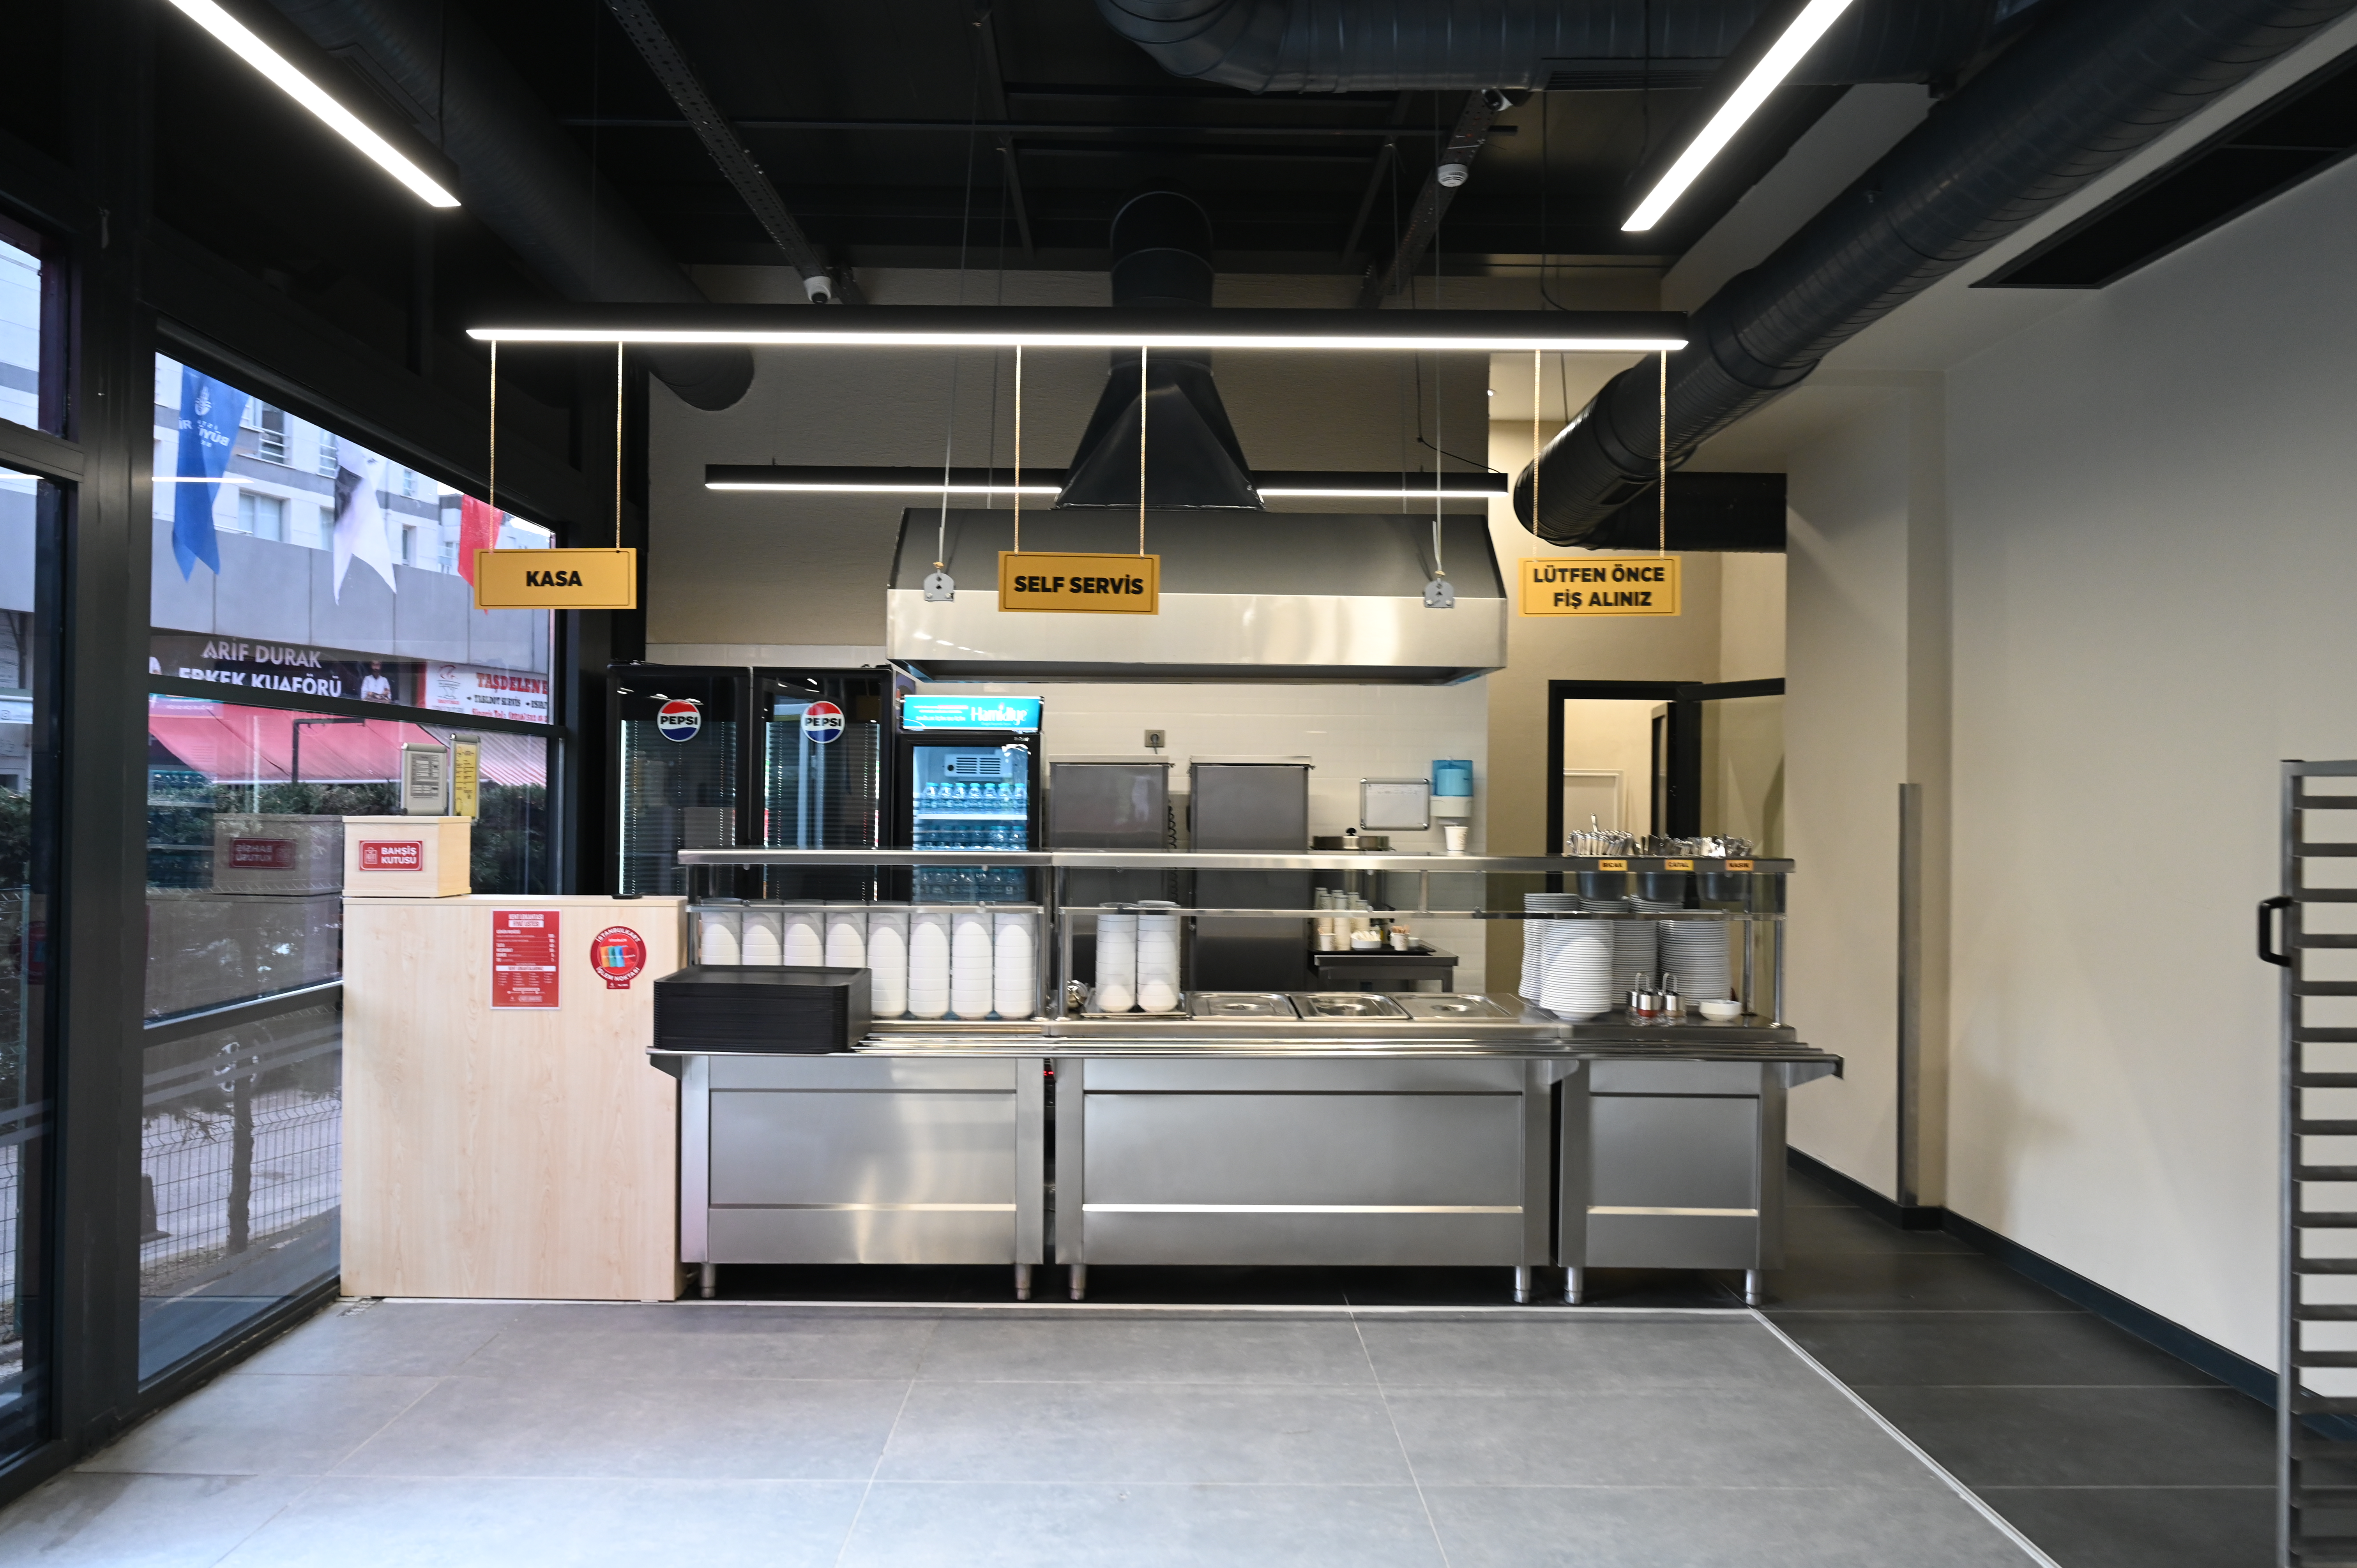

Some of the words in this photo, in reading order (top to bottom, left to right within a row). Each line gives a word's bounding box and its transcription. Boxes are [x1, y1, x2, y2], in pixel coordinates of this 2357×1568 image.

[526, 571, 583, 586] KASA
[1534, 565, 1606, 583] LÜTFEN
[1612, 564, 1665, 582] ÖNCE
[1014, 576, 1064, 592] SELF
[1069, 574, 1144, 595] SERVİS
[1553, 589, 1582, 609] FİŞ
[1588, 592, 1652, 606] ALINIZ
[200, 639, 250, 662] ARİF
[255, 645, 322, 668] DURAK
[251, 673, 342, 697] KUAFÖRÜ
[661, 715, 698, 726] PEPSI
[805, 717, 842, 727] PEPSI
[381, 845, 417, 856] BAHŞİŞ
